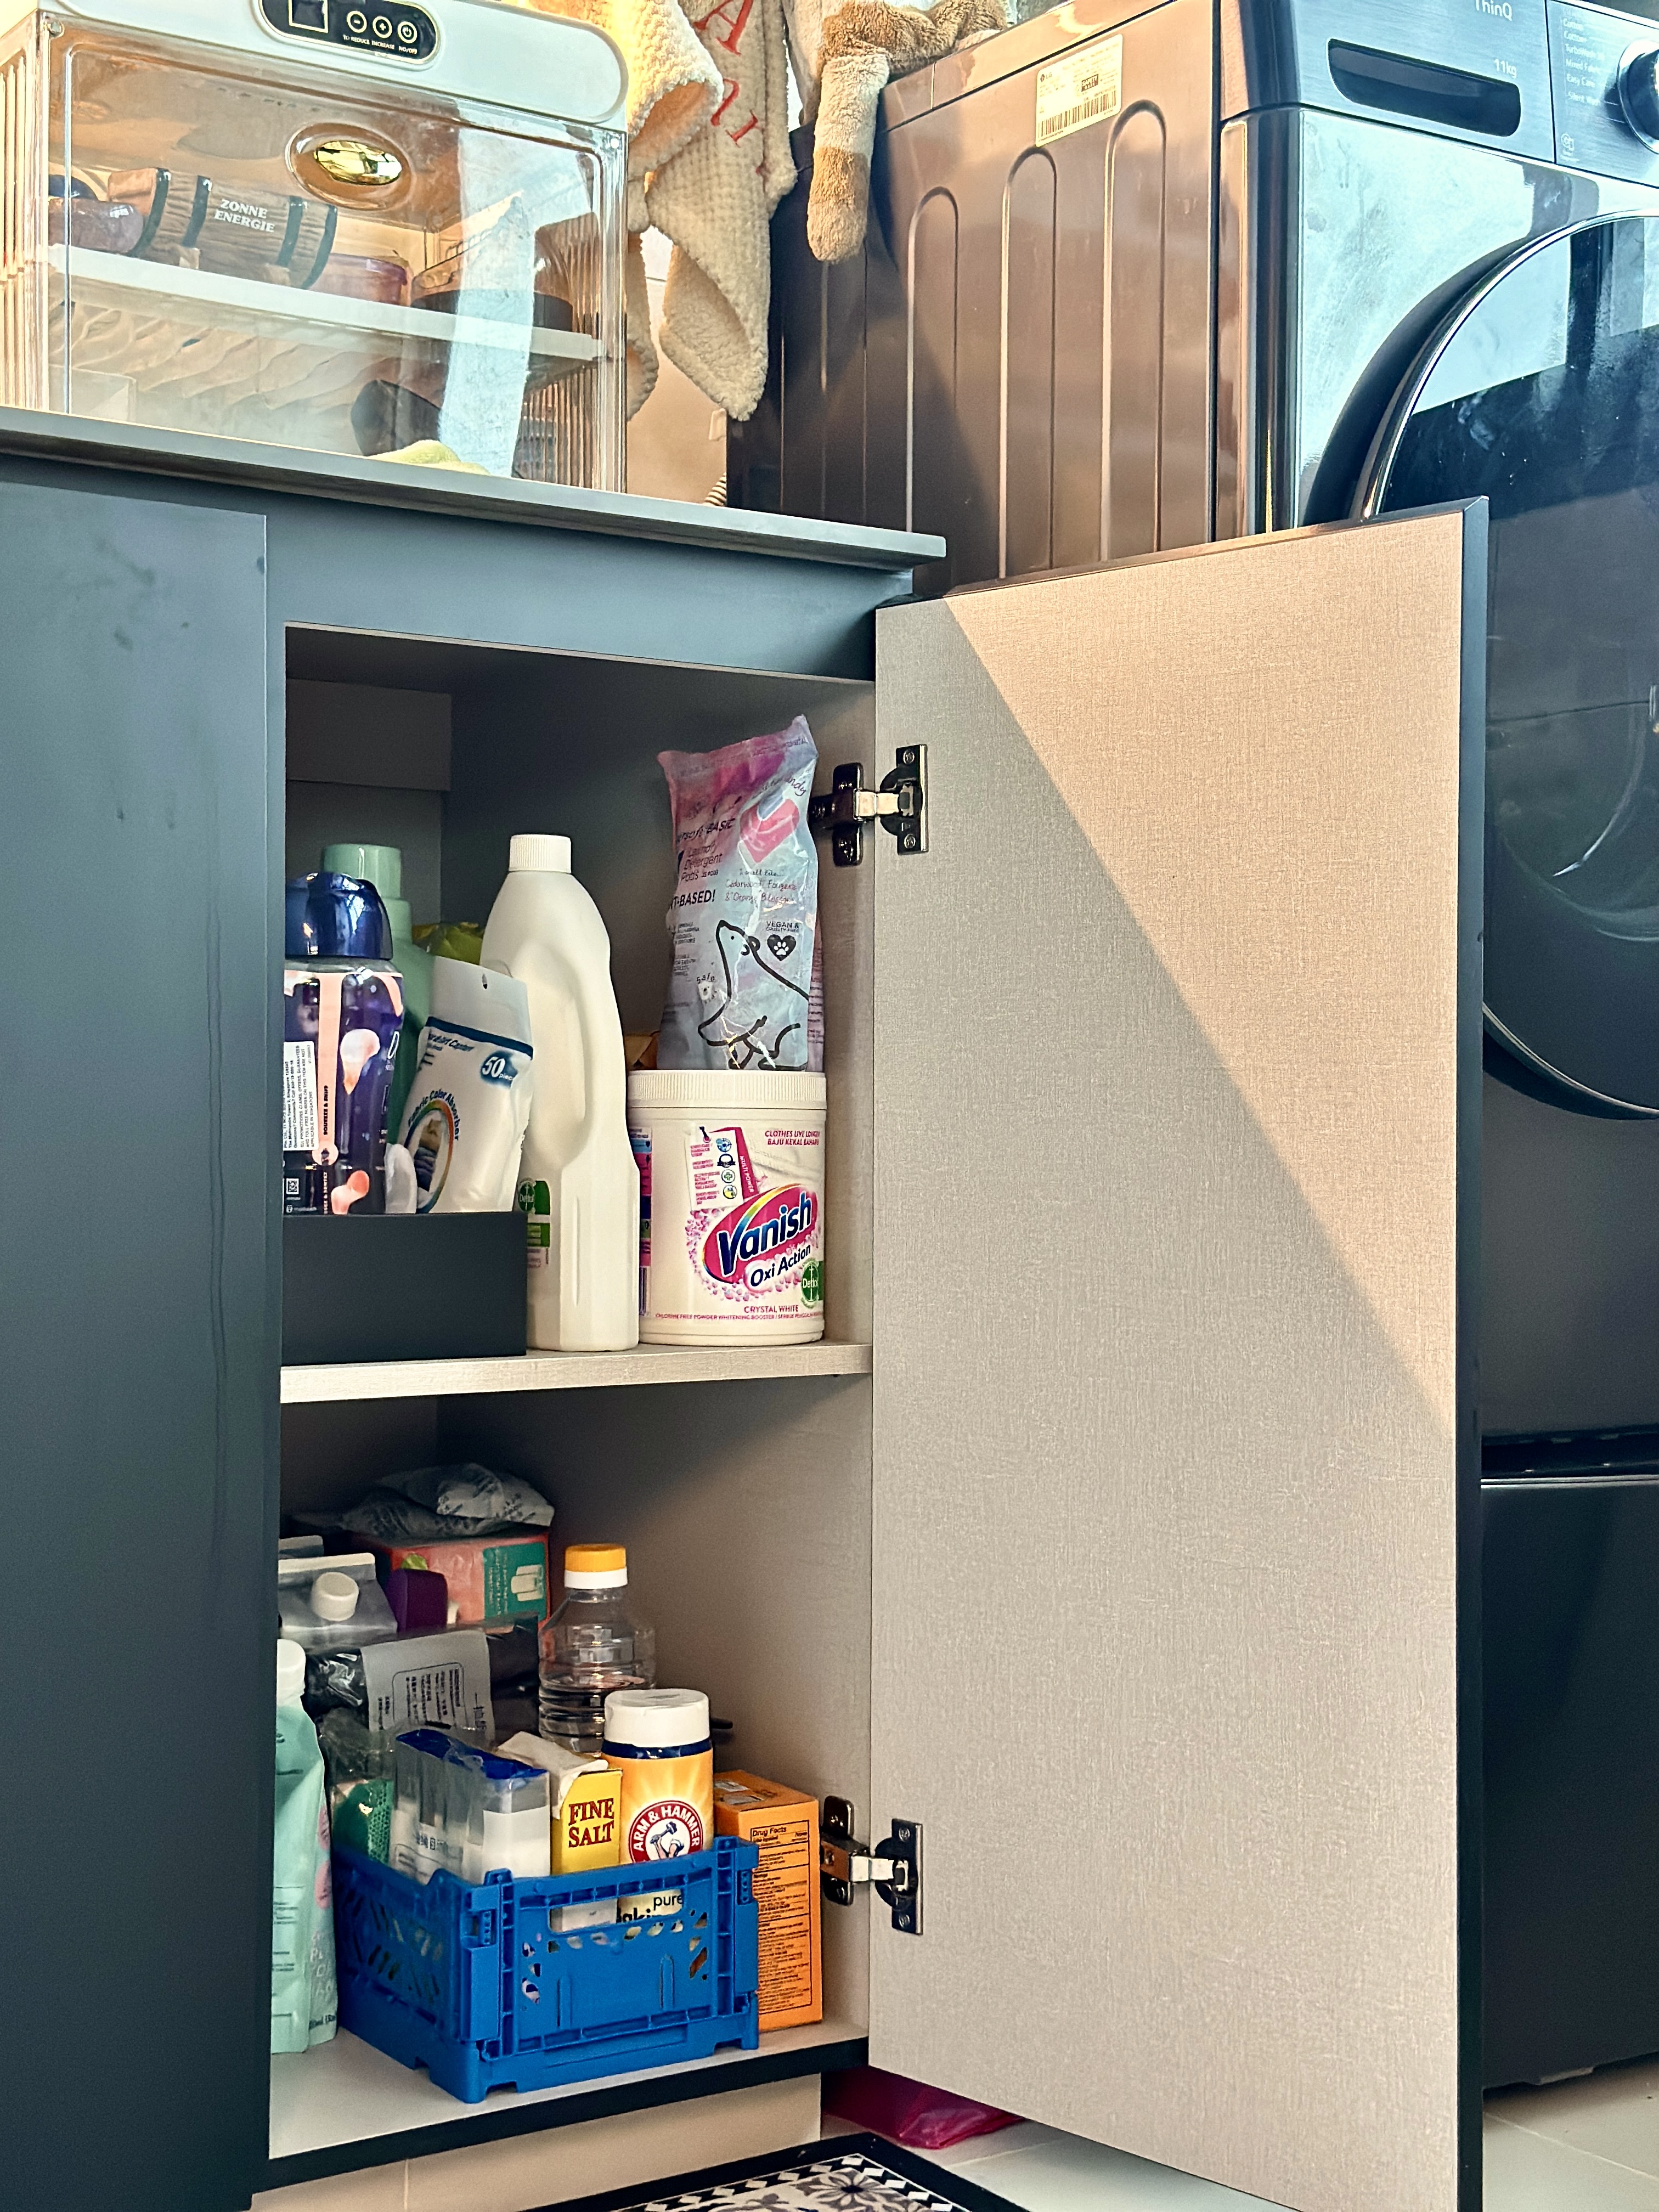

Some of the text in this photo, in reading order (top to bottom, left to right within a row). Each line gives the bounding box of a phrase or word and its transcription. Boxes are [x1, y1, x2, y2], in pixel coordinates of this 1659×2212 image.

[371, 41, 395, 49] INCREASE
[1494, 59, 1517, 79] 11kg
[1567, 74, 1595, 88] Easy Care
[221, 199, 268, 218] ZONNE
[214, 210, 275, 233] ENERGIE
[482, 1056, 505, 1078] 50
[746, 1173, 754, 1193] POWER
[717, 1192, 812, 1277] Vanish
[751, 1244, 811, 1286] Oxi Action
[568, 1798, 614, 1826] FINE
[569, 1820, 614, 1848] SALT
[633, 1805, 701, 1852] ARM & HAMMER
[653, 1894, 684, 1910] pure
